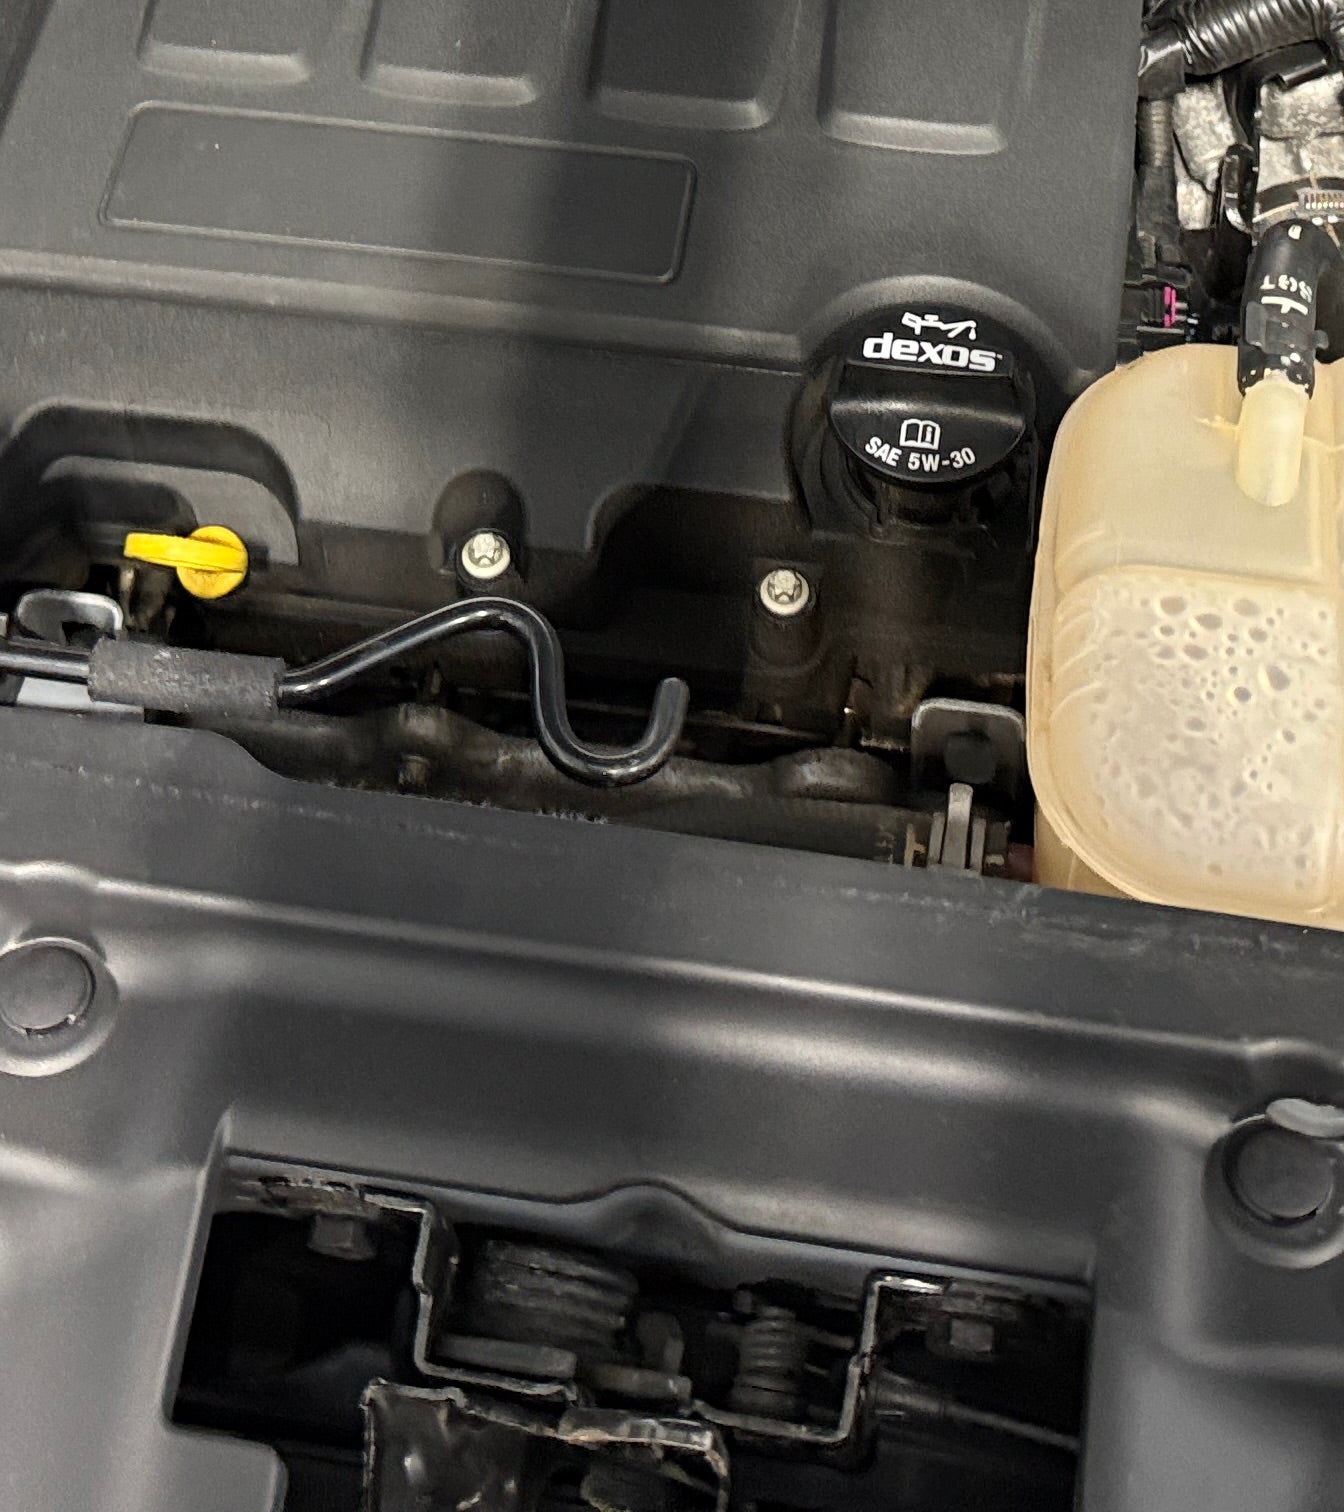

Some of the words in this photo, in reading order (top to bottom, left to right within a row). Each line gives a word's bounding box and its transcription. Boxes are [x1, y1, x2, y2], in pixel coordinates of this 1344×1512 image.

[862, 333, 997, 372] dexos
[864, 436, 903, 467] SAE
[907, 446, 976, 473] 5W-30
